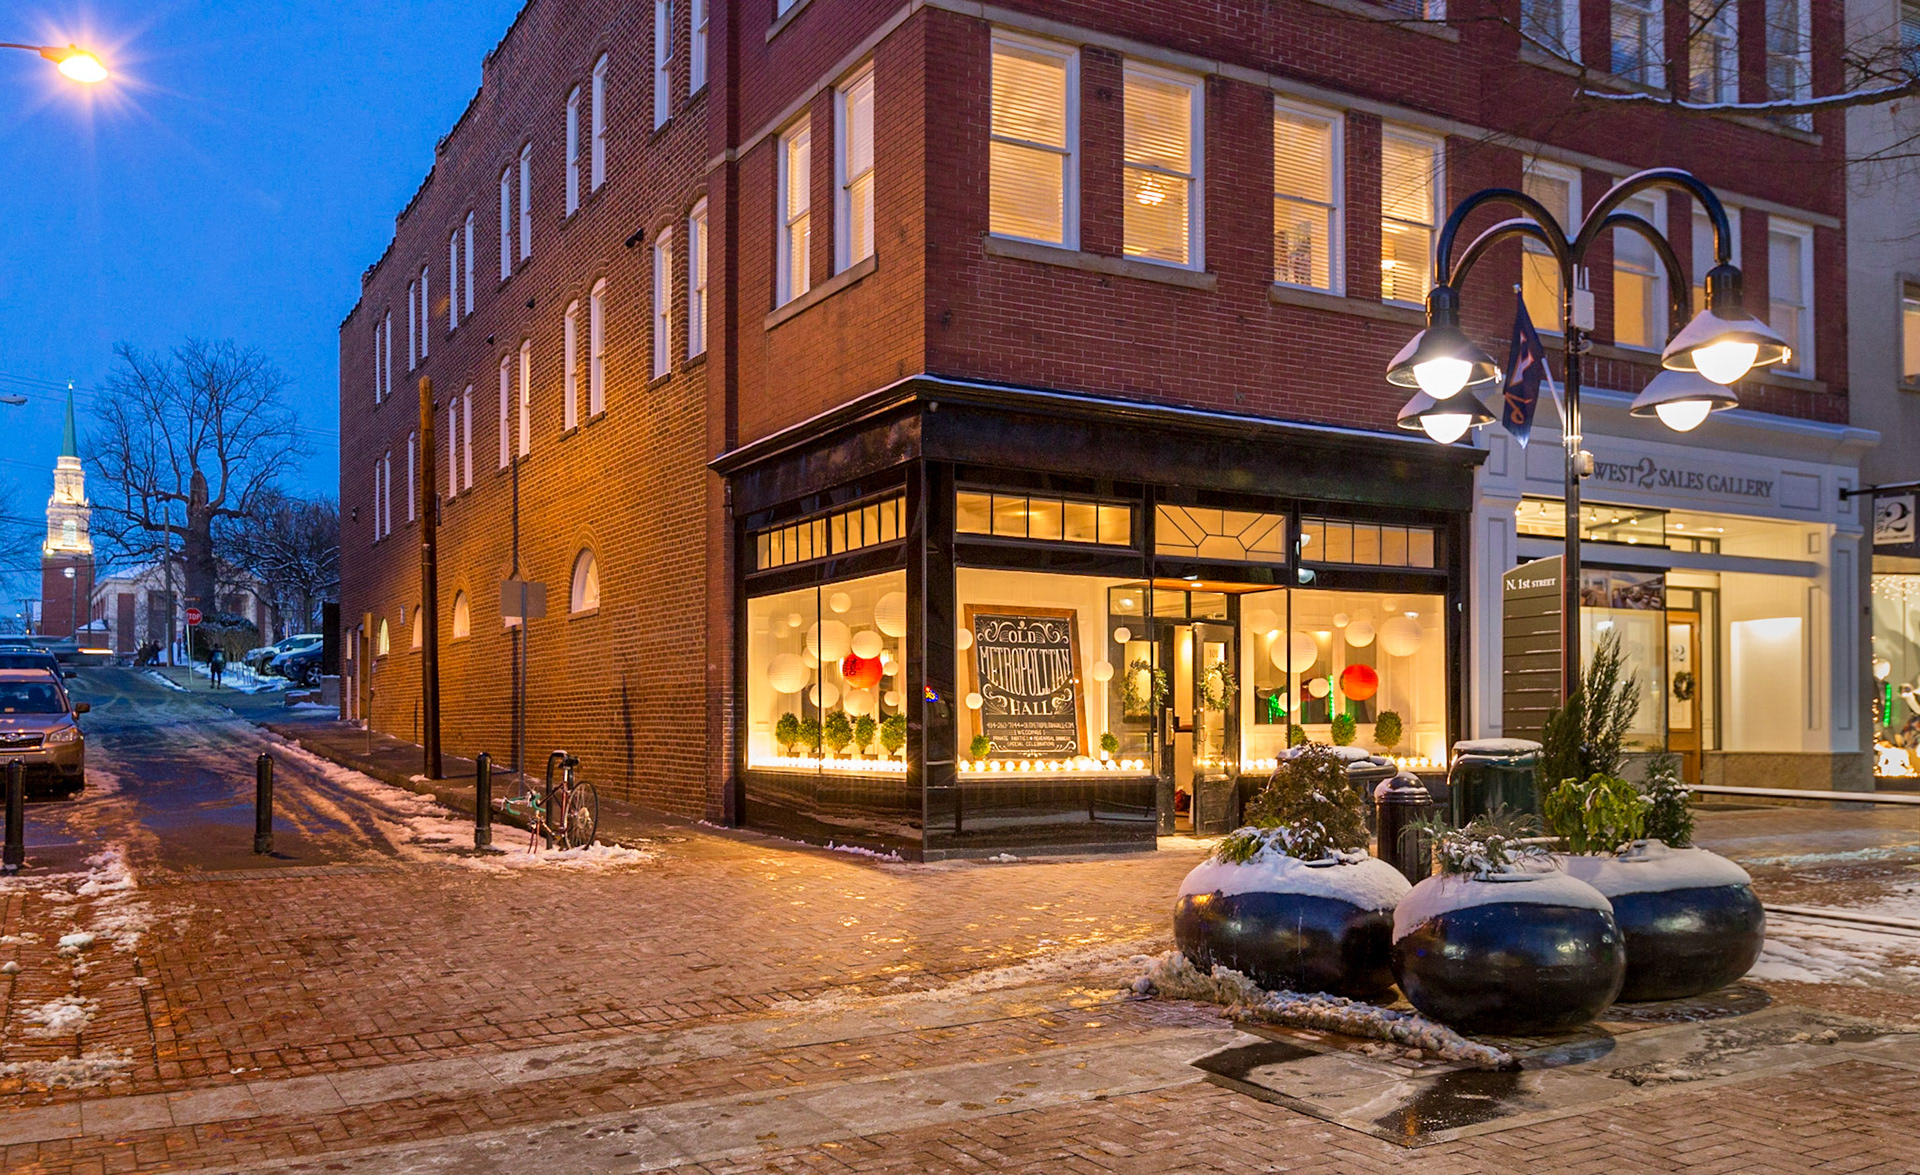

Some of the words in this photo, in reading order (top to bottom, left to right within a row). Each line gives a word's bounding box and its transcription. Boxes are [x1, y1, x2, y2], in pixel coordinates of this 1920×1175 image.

[1594, 461, 1638, 483] WEST
[1658, 468, 1704, 491] SALES
[1706, 475, 1775, 498] GALLERY
[1884, 502, 1912, 533] 2
[1506, 579, 1516, 590] N.
[1531, 578, 1556, 588] STREET
[1008, 630, 1037, 643] OLD
[979, 646, 1071, 696] METROPOLITAN
[1009, 697, 1053, 715] HALL
